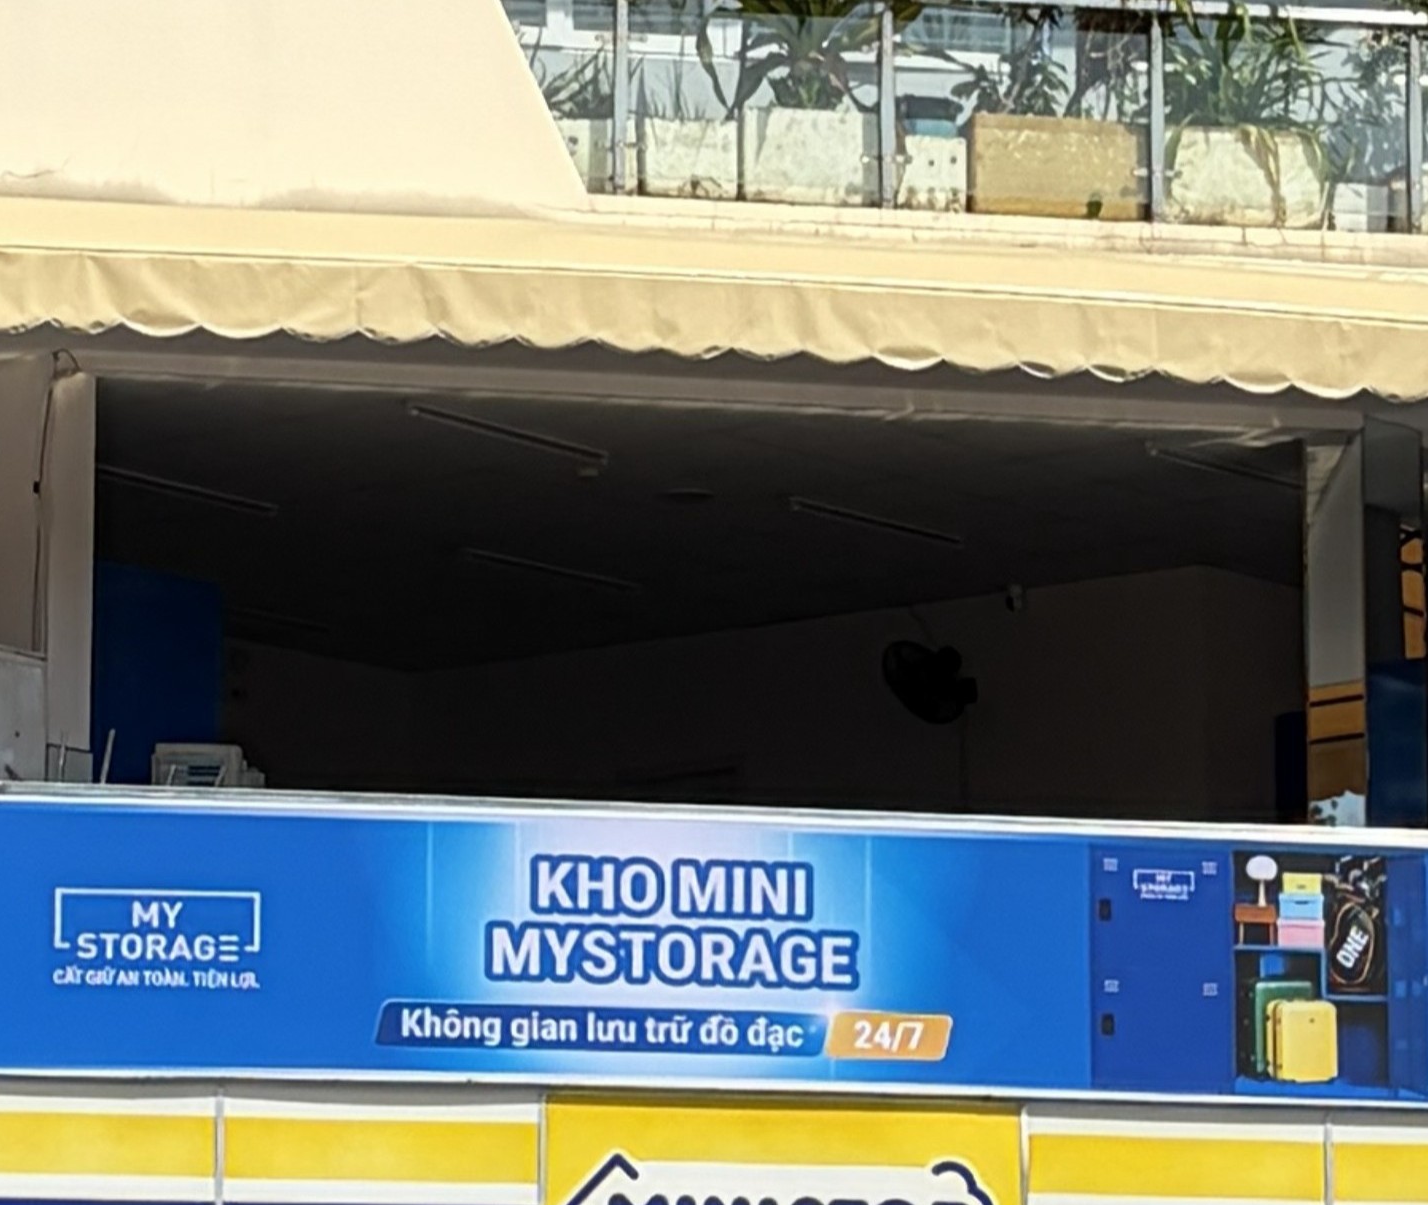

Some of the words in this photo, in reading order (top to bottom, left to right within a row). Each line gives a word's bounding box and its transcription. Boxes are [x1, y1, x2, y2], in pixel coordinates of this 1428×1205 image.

[534, 860, 662, 915] KHO
[676, 863, 810, 918] MINI
[132, 900, 183, 929] MY
[77, 933, 240, 962] STORAGE
[489, 926, 856, 987] MYSTORAGE
[1336, 925, 1369, 968] ONE
[400, 1009, 502, 1046] Không
[510, 1010, 576, 1046] gian
[587, 1011, 637, 1043] lưu
[644, 1014, 693, 1045] trữ
[699, 1013, 739, 1046] đồ
[747, 1016, 805, 1053] đạc
[853, 1020, 923, 1053] 24/7
